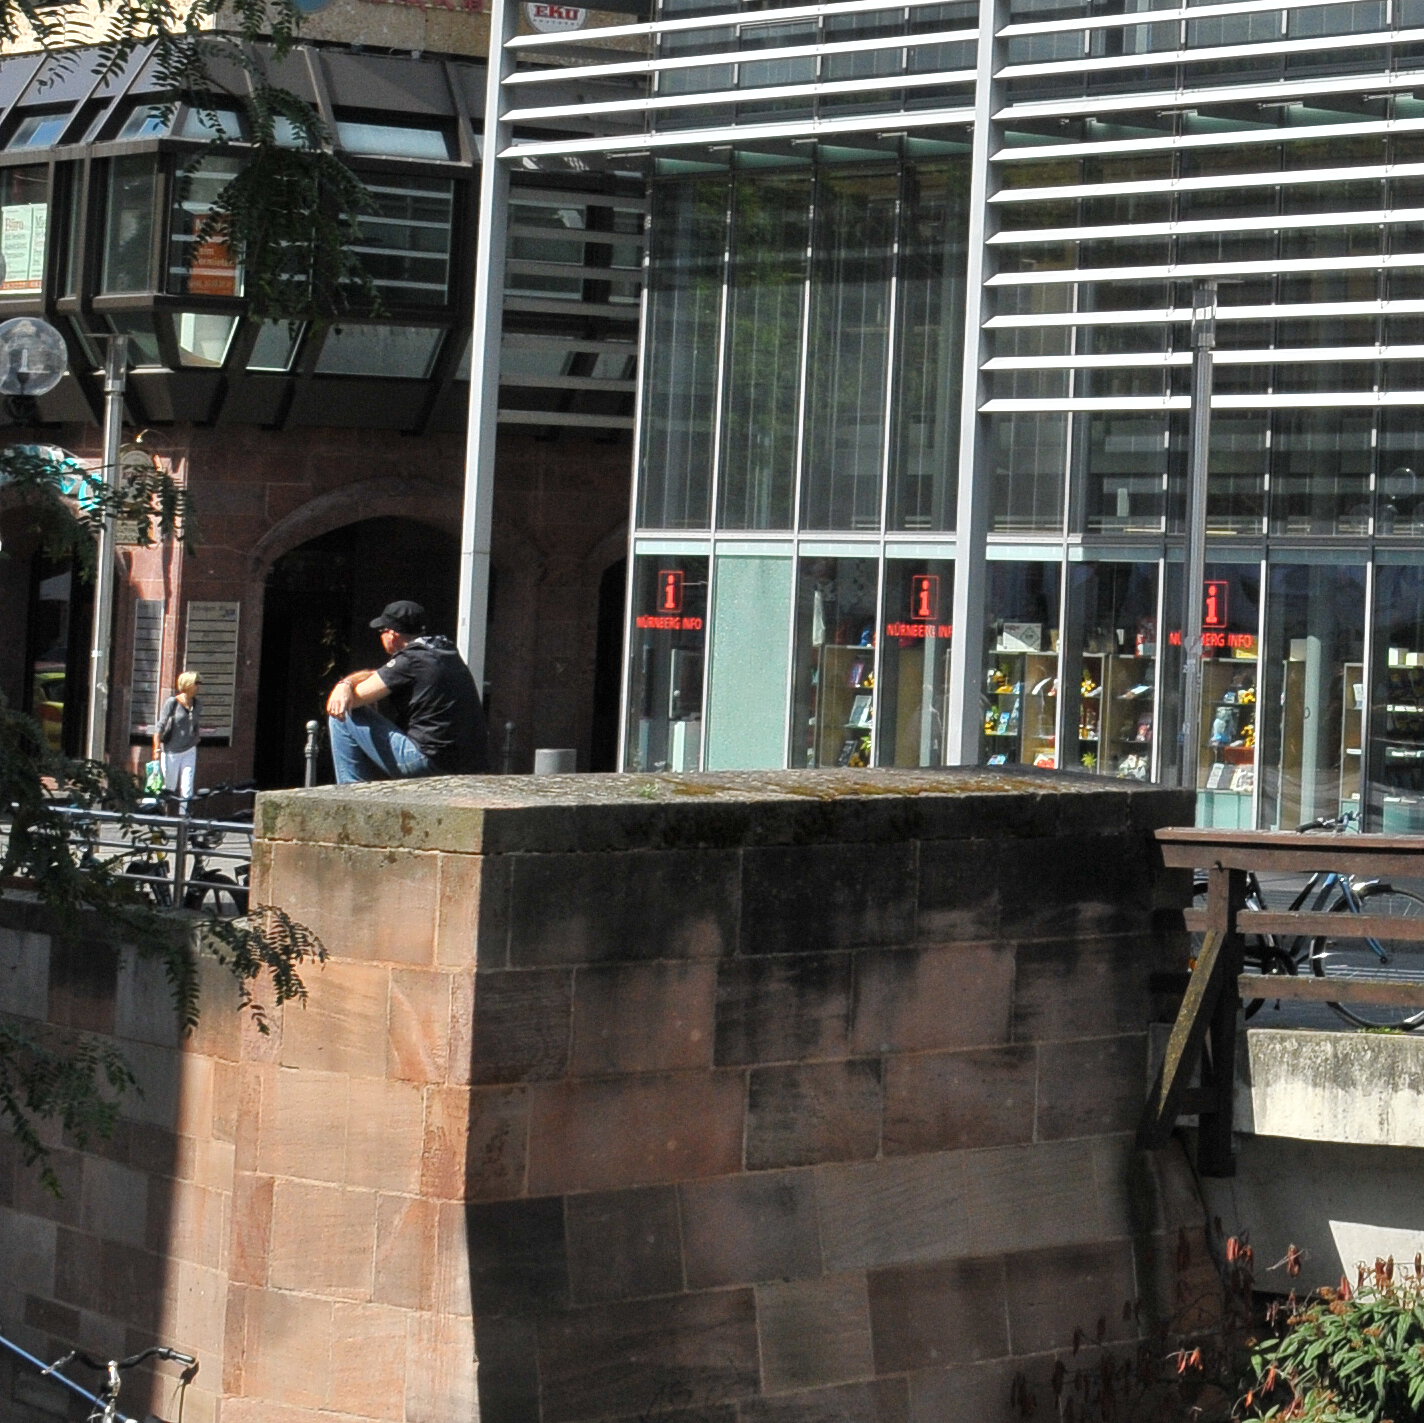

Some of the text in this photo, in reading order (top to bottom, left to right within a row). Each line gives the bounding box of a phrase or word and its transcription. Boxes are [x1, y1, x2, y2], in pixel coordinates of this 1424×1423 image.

[534, 5, 579, 20] EKU
[637, 615, 702, 630] NÜRNBERG INFO
[887, 621, 936, 638] NÜRNBERG
[1228, 633, 1253, 648] INFO
